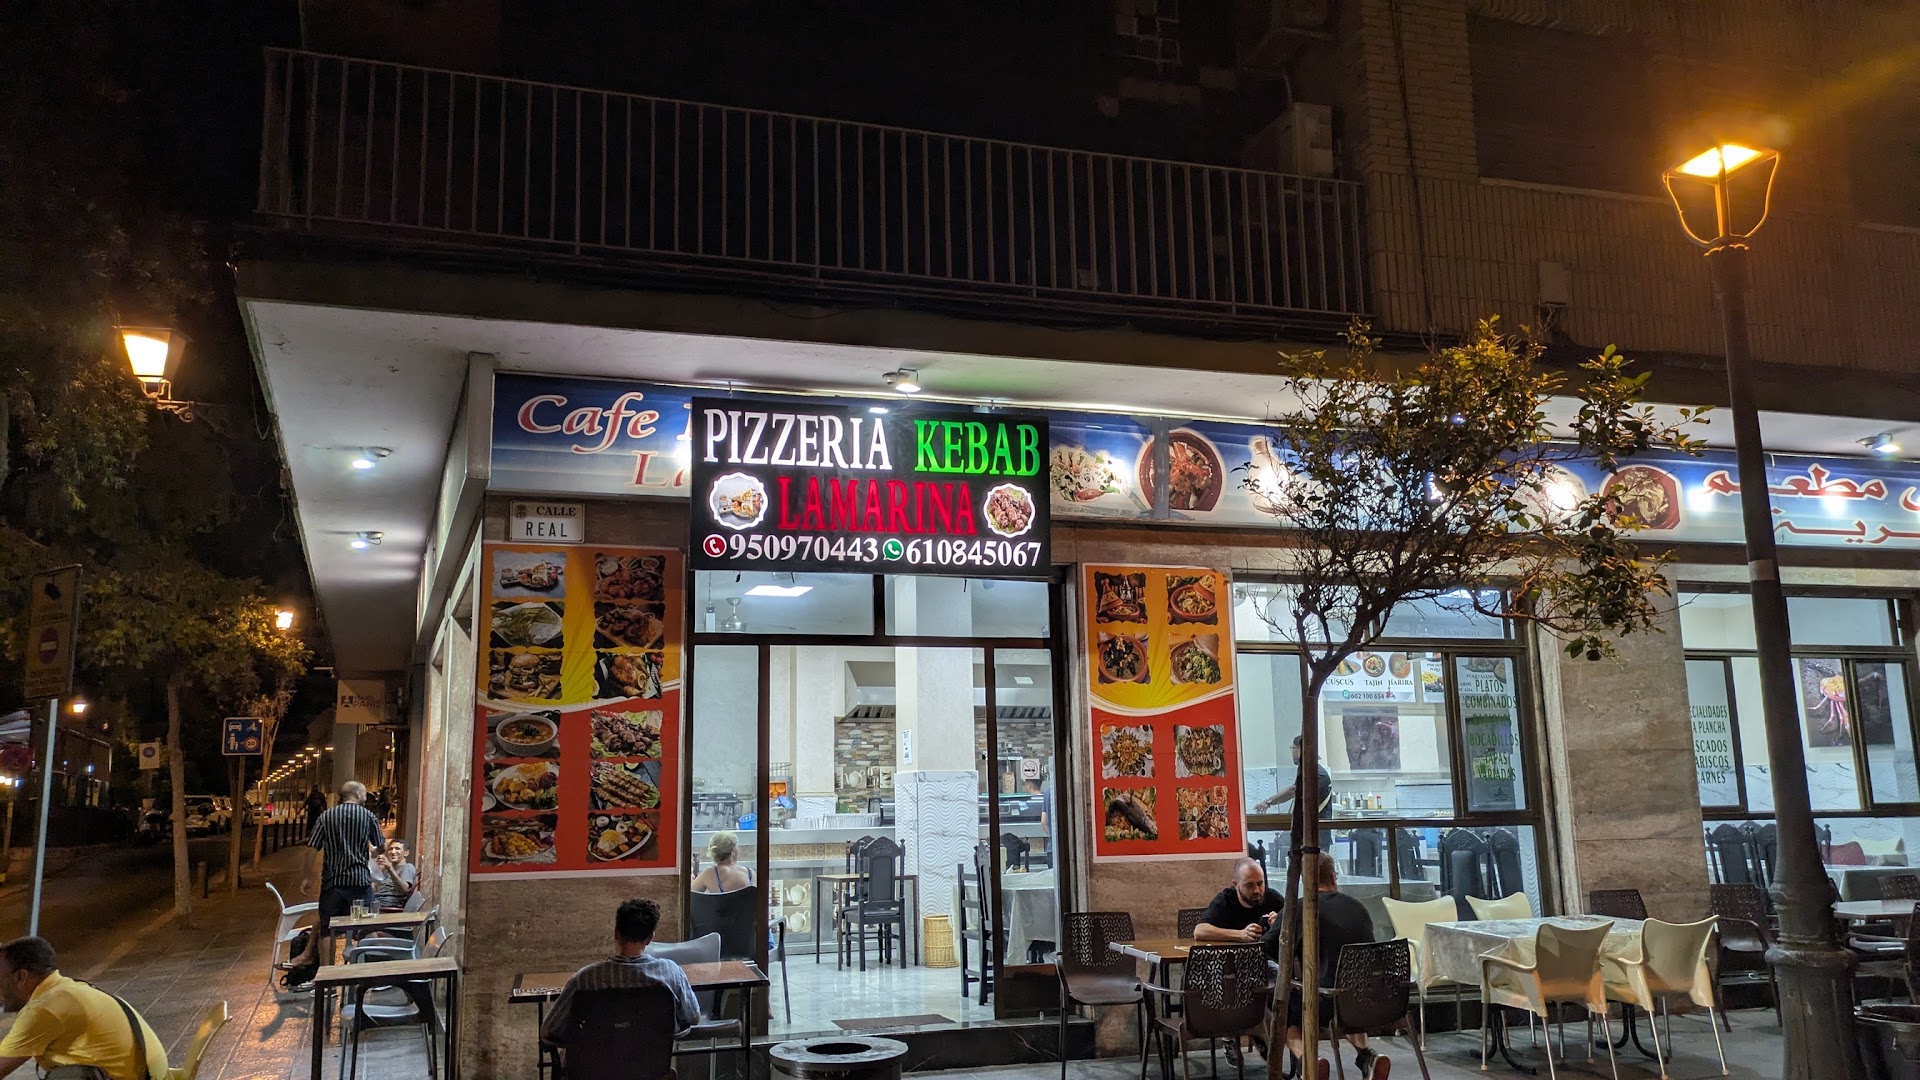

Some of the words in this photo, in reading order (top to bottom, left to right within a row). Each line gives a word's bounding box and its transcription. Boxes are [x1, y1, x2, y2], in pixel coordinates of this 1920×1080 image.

[518, 392, 659, 454] Cafe
[703, 409, 892, 471] PIZZERIA
[914, 419, 1041, 477] KEBAB
[536, 505, 577, 518] CALLE
[776, 475, 978, 535] LAMARINA
[525, 521, 568, 538] REAL
[729, 533, 879, 562] 950970443
[906, 538, 1042, 567] 610845067
[1388, 679, 1414, 687] HARIRA
[1475, 679, 1505, 693] PLATOS
[1465, 695, 1517, 709] COMBINADOS
[1699, 721, 1727, 734] PLANCHA
[1468, 733, 1519, 747] BOCADILLOS
[1485, 752, 1508, 765] TAPAS
[1478, 768, 1516, 782] VARIADAS
